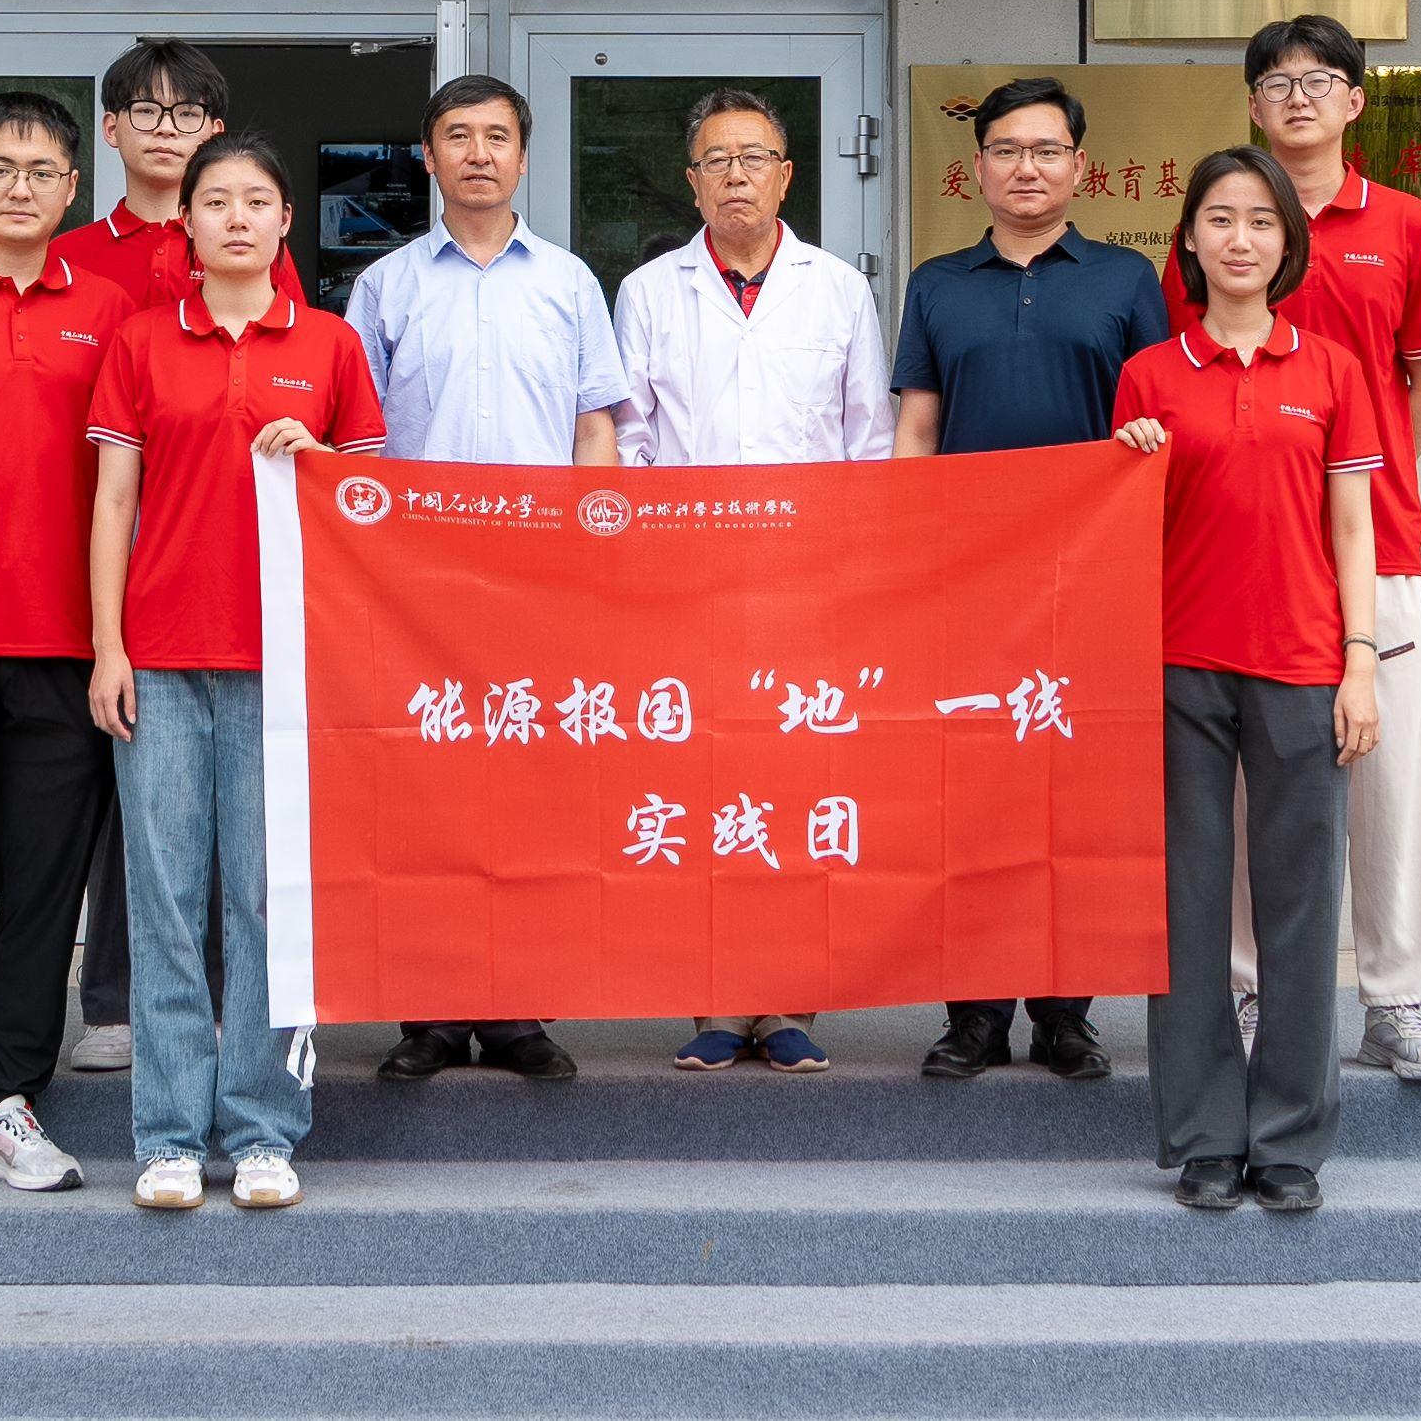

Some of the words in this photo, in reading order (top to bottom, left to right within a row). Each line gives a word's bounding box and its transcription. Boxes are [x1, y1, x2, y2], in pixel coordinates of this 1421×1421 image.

[402, 512, 430, 522] CHINA
[434, 515, 487, 526] UNIVERSITY
[642, 521, 687, 529] School
[694, 521, 706, 529] of
[622, 792, 860, 870] 实践团
